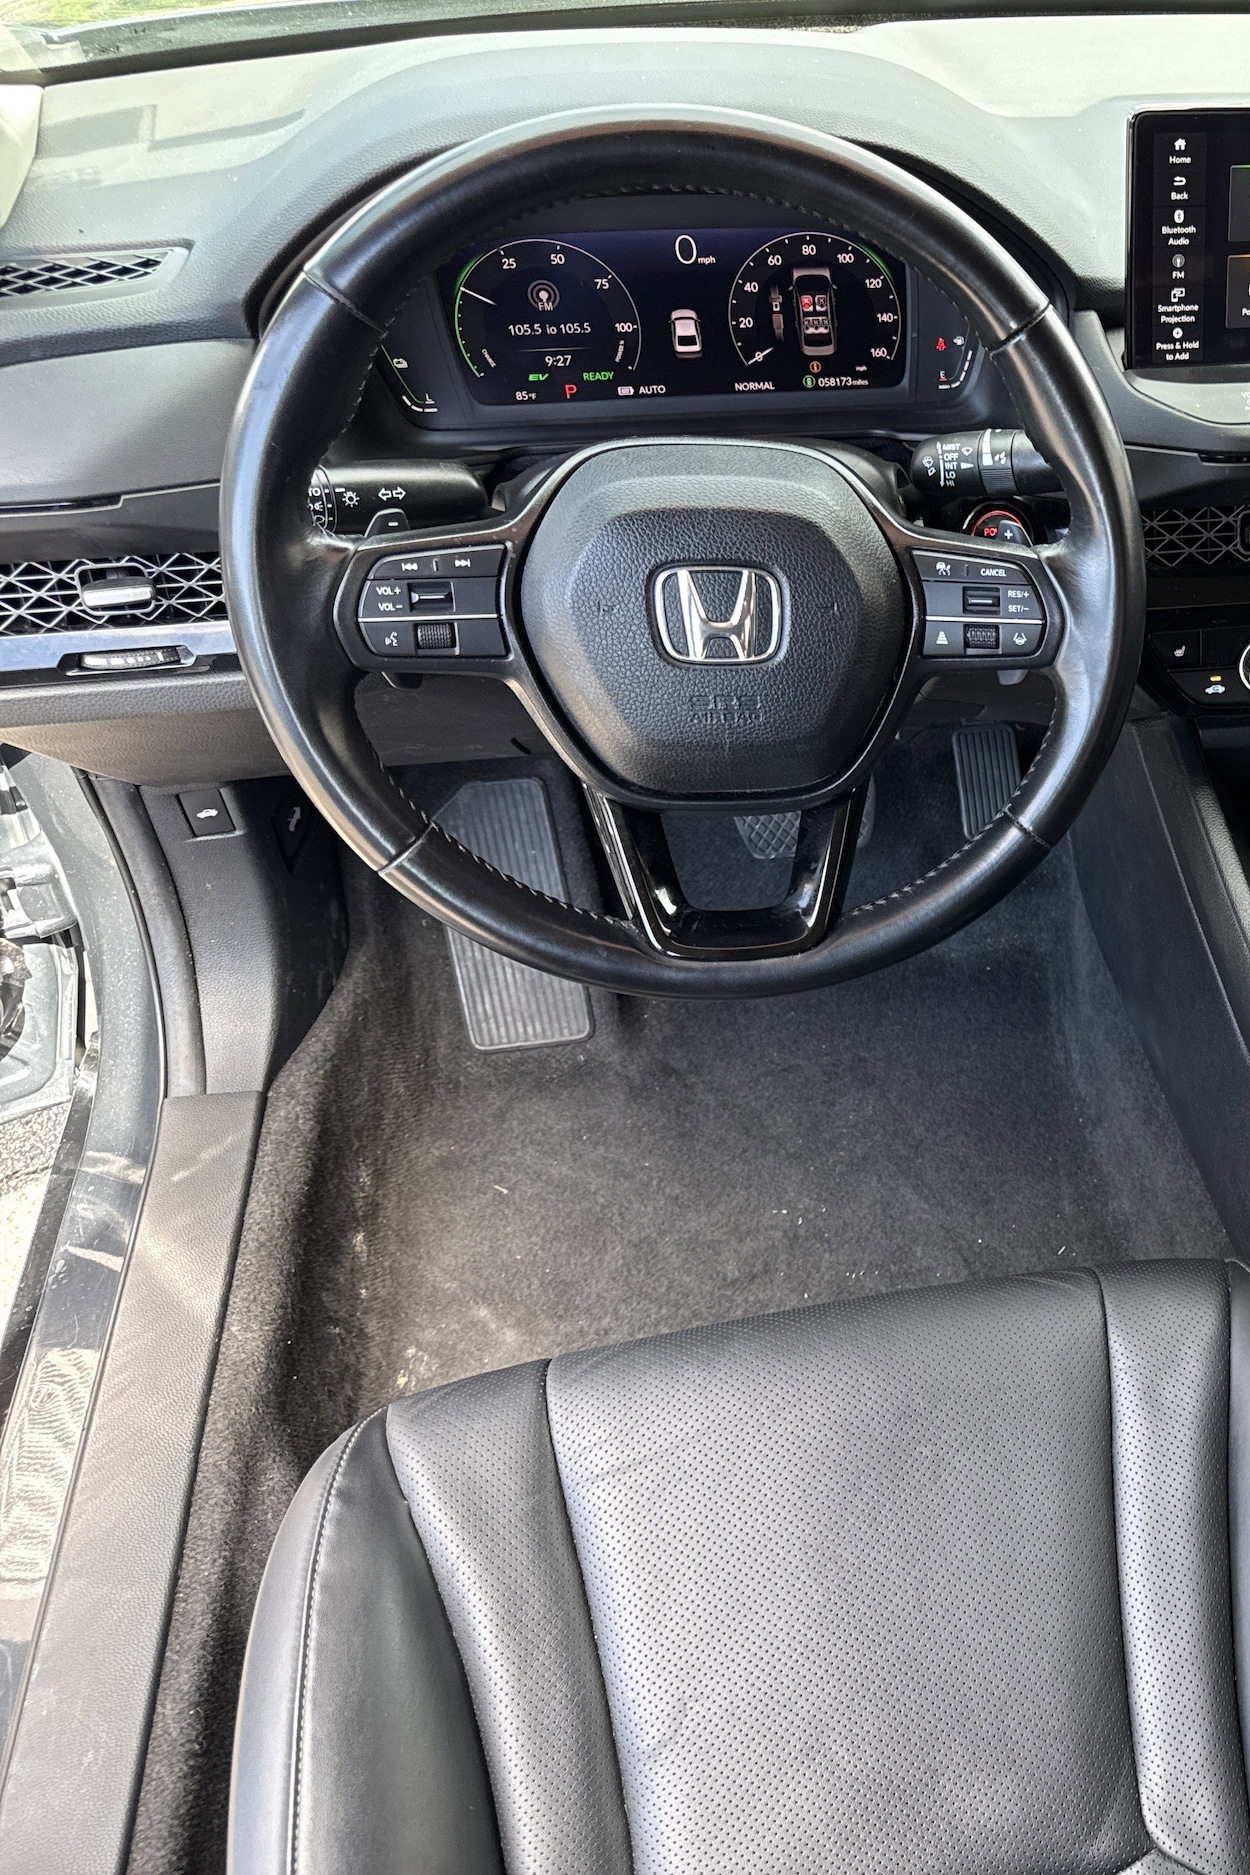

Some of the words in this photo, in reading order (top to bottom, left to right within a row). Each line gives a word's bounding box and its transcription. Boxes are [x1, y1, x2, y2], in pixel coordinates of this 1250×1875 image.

[1169, 155, 1191, 164] Home
[1171, 191, 1188, 200] Back
[1161, 225, 1196, 235] Bluetooth
[1168, 236, 1190, 246] Audio
[674, 234, 697, 265] 0
[802, 244, 817, 256] 80
[501, 257, 517, 269] 25
[550, 253, 565, 265] 50
[697, 255, 716, 265] mph
[767, 255, 782, 266] 60
[836, 253, 854, 264] 100
[1172, 270, 1185, 280] FM
[594, 278, 610, 290] 75
[744, 282, 759, 293] 40
[865, 278, 882, 289] 120
[537, 302, 554, 311] FM
[1157, 303, 1199, 314] Smartphone
[739, 318, 753, 328] 20
[877, 313, 894, 323] 140
[1160, 314, 1196, 324] Projection
[508, 324, 542, 336] 105.5
[559, 323, 591, 334] 105.5
[614, 322, 633, 332] 100
[1156, 341, 1174, 351] Press
[1175, 341, 1181, 350] &
[1182, 340, 1200, 350] Hold
[870, 347, 887, 358] 160
[1165, 353, 1173, 361] to
[1174, 352, 1190, 361] Add
[545, 355, 572, 367] 9:27
[528, 373, 549, 381] EV
[583, 371, 615, 381] READY
[734, 381, 776, 392] NORMAL
[818, 376, 852, 387] 058173
[565, 384, 578, 399] P
[638, 385, 666, 394] AUTO
[942, 443, 960, 451] MIST
[944, 453, 959, 461] OFF
[945, 462, 957, 470] INT
[945, 471, 956, 479] LO
[980, 568, 1007, 577] CANCEL
